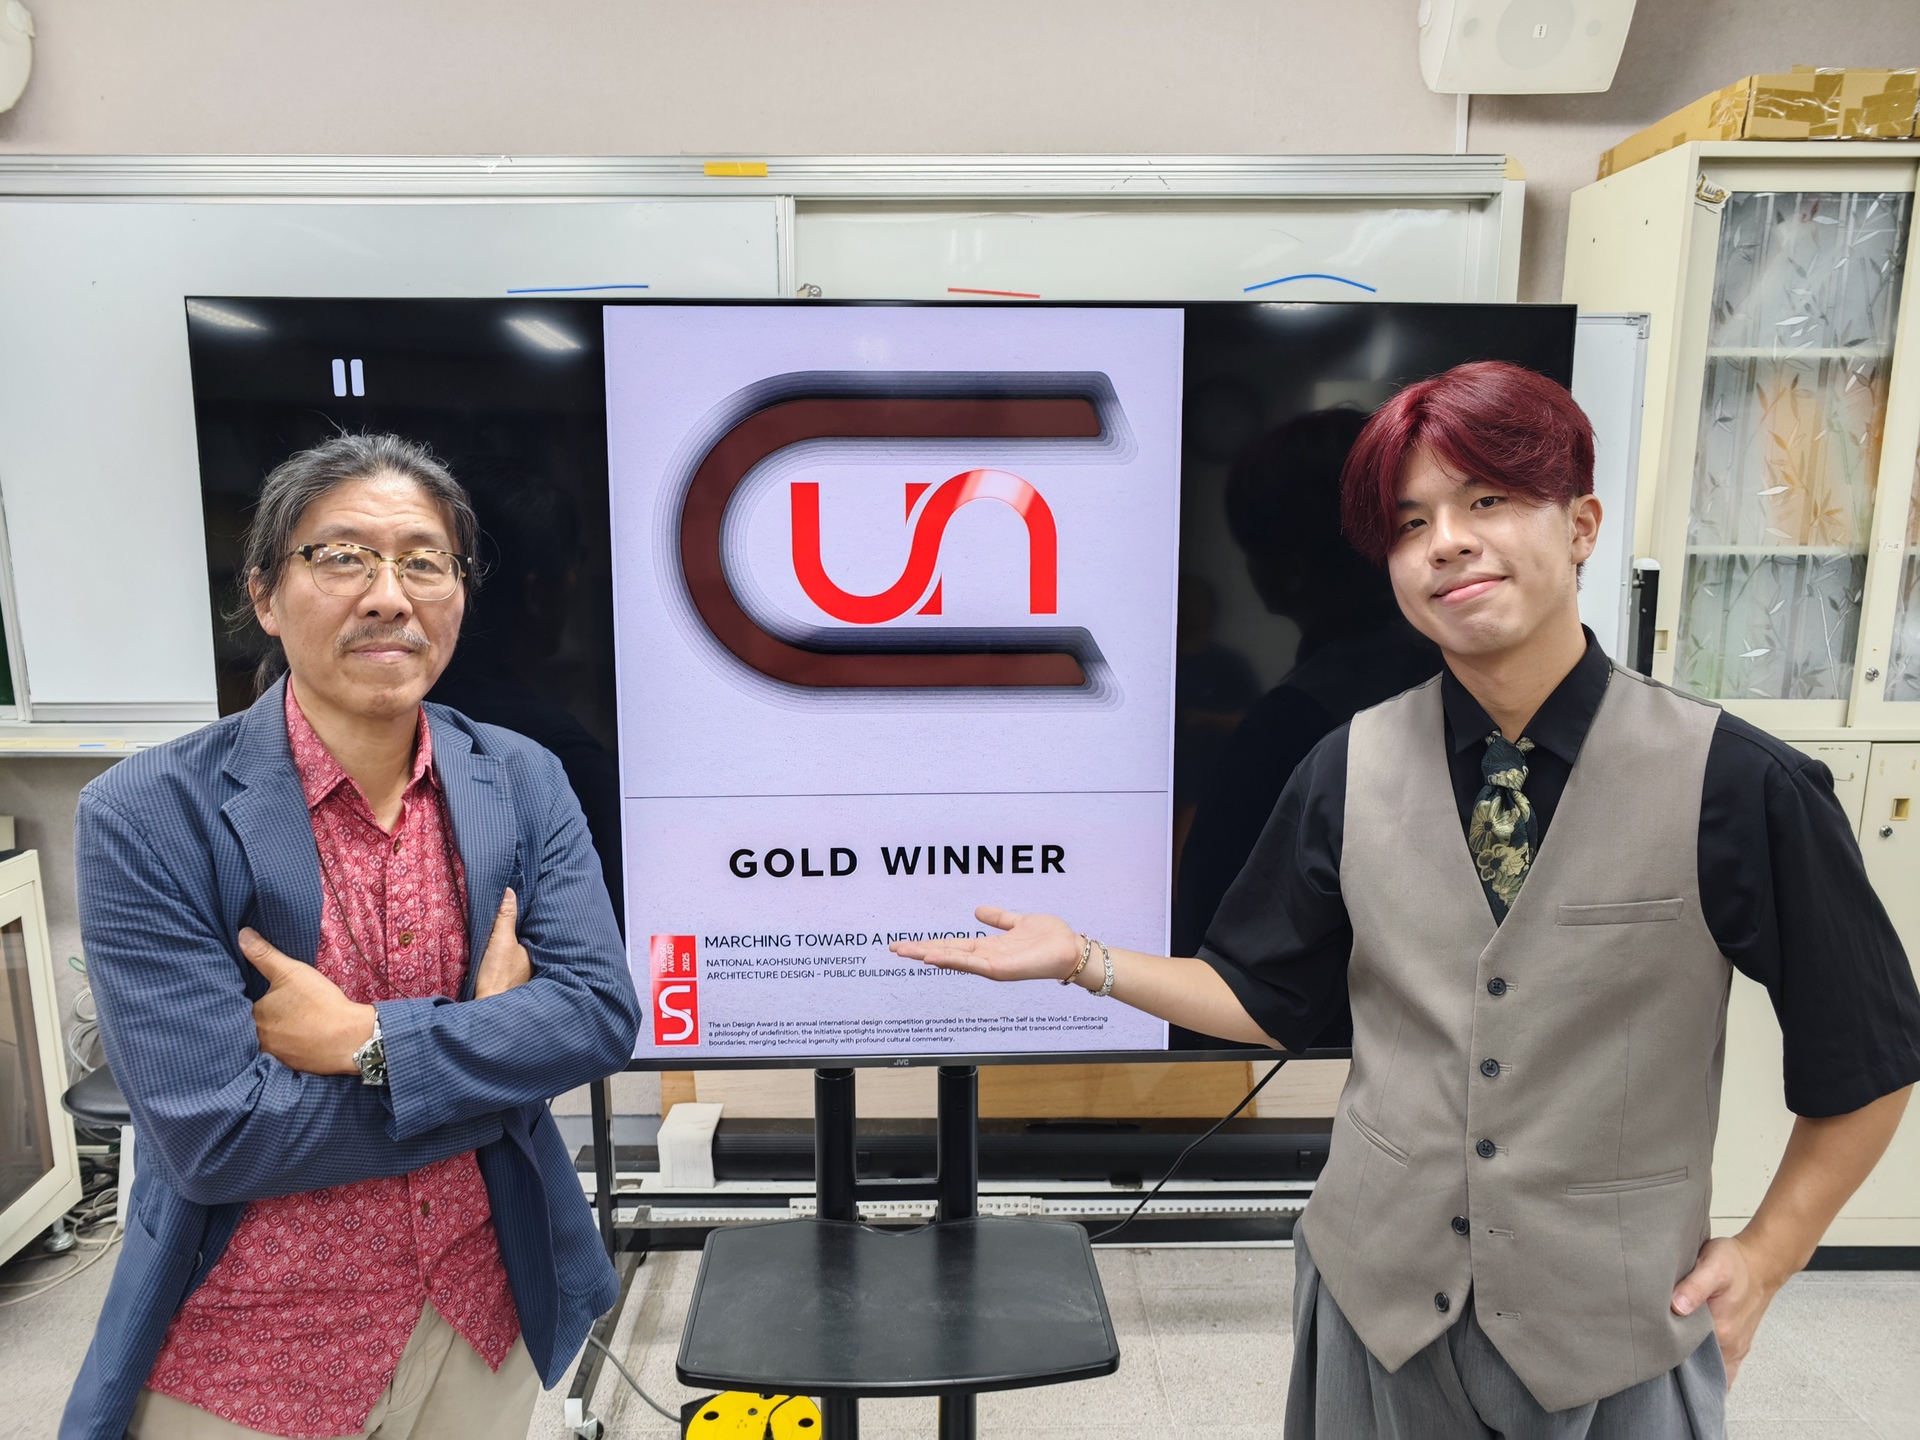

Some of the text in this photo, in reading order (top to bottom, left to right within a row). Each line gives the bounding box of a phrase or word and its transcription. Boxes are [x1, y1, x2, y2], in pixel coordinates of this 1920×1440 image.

[729, 844, 1068, 879] GOLD WINNER
[705, 935, 792, 948] MARCHING
[795, 933, 867, 946] TOWARD
[871, 932, 883, 946] A
[887, 932, 924, 945] NEW
[660, 943, 668, 973] DESIGN
[667, 943, 675, 973] AWARD
[682, 952, 690, 972] 2025
[706, 956, 867, 967] NATIONAL KAOHSIUNG UNIVERSITY
[707, 971, 779, 980] ARCHITECTURE
[780, 970, 815, 979] DESIGN
[823, 969, 857, 978] PUBLIC
[858, 968, 907, 978] BUILDINGS
[908, 968, 916, 976] &
[714, 1029, 751, 1038] philosophy
[751, 1028, 759, 1036] of
[801, 1027, 813, 1035] the
[813, 1027, 842, 1035] initiative
[842, 1026, 876, 1035] spotlights
[876, 1025, 910, 1034] innovative
[911, 1024, 934, 1033] talents
[934, 1024, 947, 1033] and
[947, 1024, 988, 1033] outstanding
[988, 1023, 1013, 1033] designs
[1013, 1022, 1028, 1031] that
[1028, 1022, 1062, 1031] transcend
[1061, 1021, 1104, 1030] conventional
[732, 1021, 755, 1029] Design
[756, 1020, 778, 1028] Award
[861, 1018, 883, 1027] design
[884, 1017, 924, 1026] competition
[925, 1017, 957, 1026] grounded
[965, 1016, 977, 1024] the
[1035, 1014, 1047, 1022] the
[1072, 1014, 1108, 1023] Embracing
[748, 1038, 777, 1046] merging
[777, 1037, 808, 1045] technical
[808, 1036, 839, 1045] ingenuity
[839, 1035, 855, 1043] with
[855, 1034, 886, 1044] profound
[886, 1034, 911, 1043] cultural
[911, 1033, 956, 1043] commentary.
[893, 1058, 910, 1066] JVC
